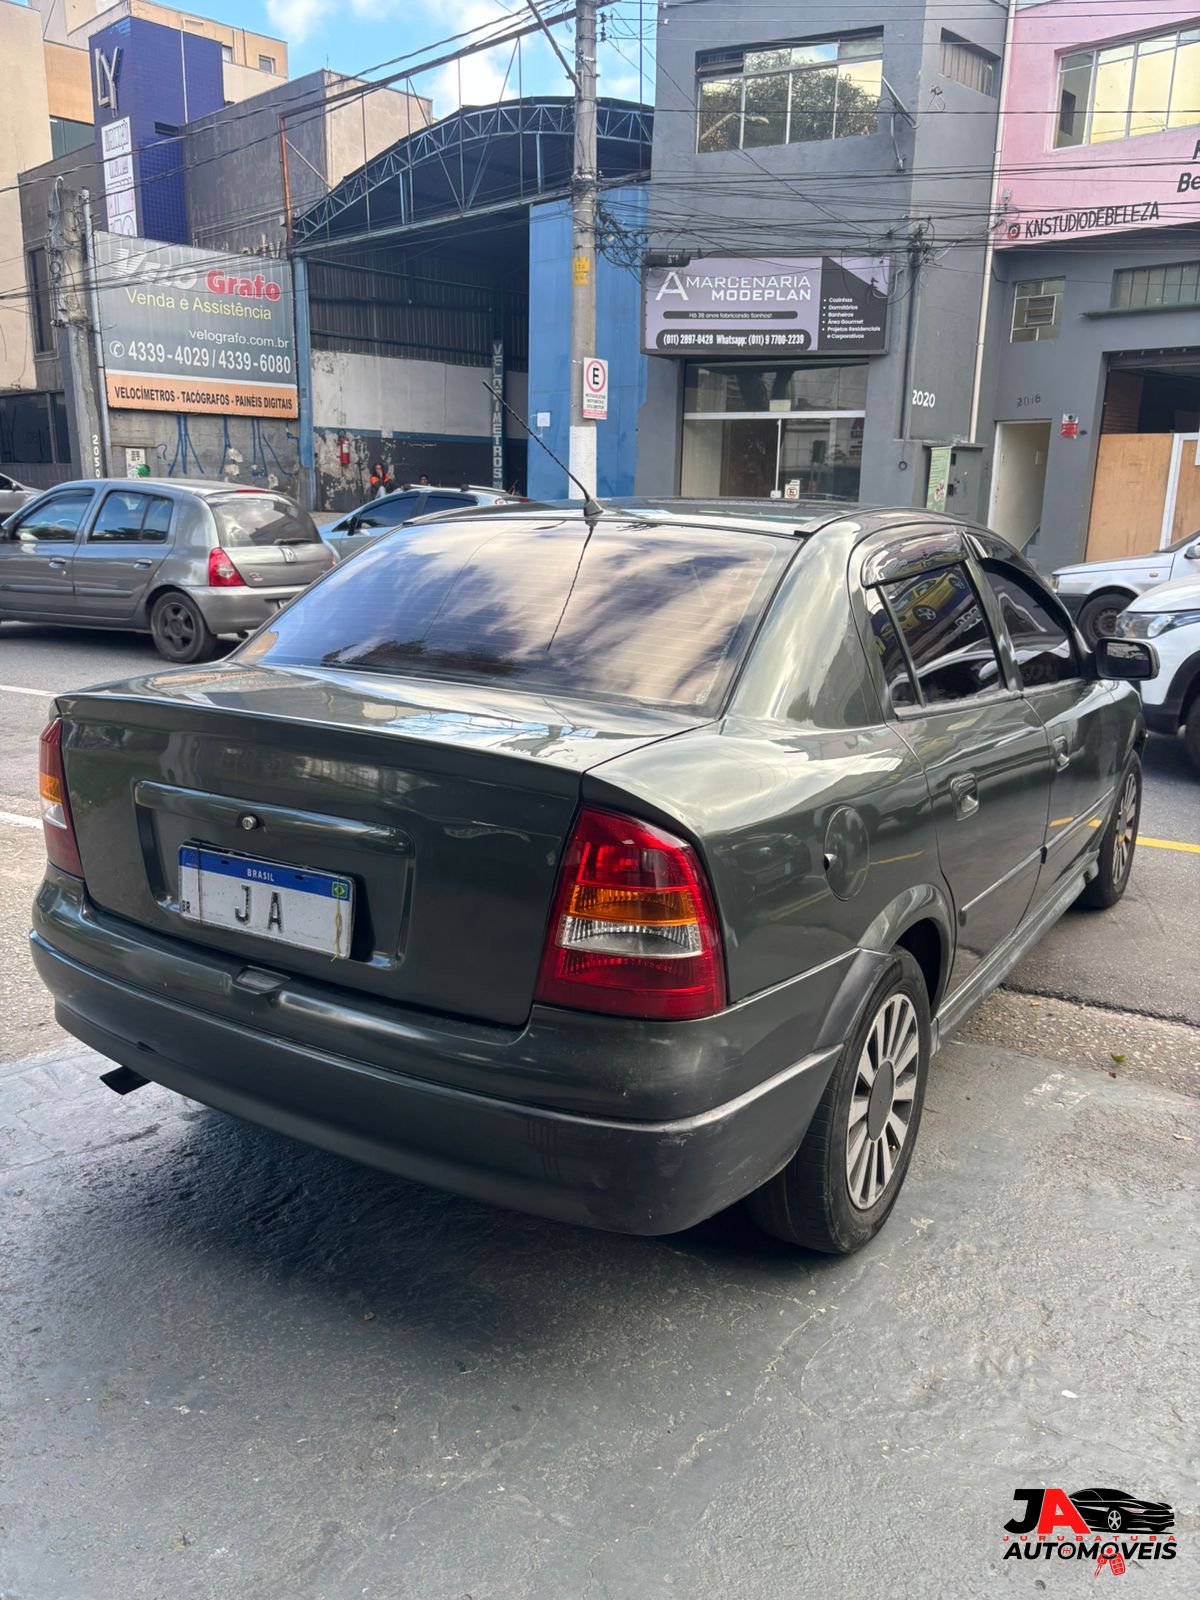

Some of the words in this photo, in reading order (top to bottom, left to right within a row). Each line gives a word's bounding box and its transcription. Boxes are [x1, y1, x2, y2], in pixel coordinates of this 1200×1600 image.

[1025, 201, 1160, 239] KNSTUDIODEBELEZA
[205, 269, 282, 302] Grafo
[686, 275, 811, 289] MARCENARIA
[125, 287, 175, 309] Venda
[179, 298, 190, 310] e
[192, 296, 272, 320] Assistência
[711, 289, 812, 301] MODEPLAN
[189, 329, 290, 349] velografo.com.br
[663, 333, 680, 345] (011)
[680, 333, 714, 345] 2897-0428
[716, 333, 748, 347] Whatsapp:
[748, 334, 765, 346] (011)
[764, 334, 770, 345] 9
[770, 333, 805, 345] 7700-2239
[592, 367, 600, 385] E
[114, 385, 176, 402] VELOCÍMETROS
[180, 389, 230, 406] TACÓGRAFOS
[263, 397, 293, 410] DIGITAIS
[911, 389, 936, 408] 2020
[92, 434, 101, 478] 2050
[247, 868, 275, 882] BRASIL
[234, 884, 250, 924] J
[267, 891, 283, 934] A
